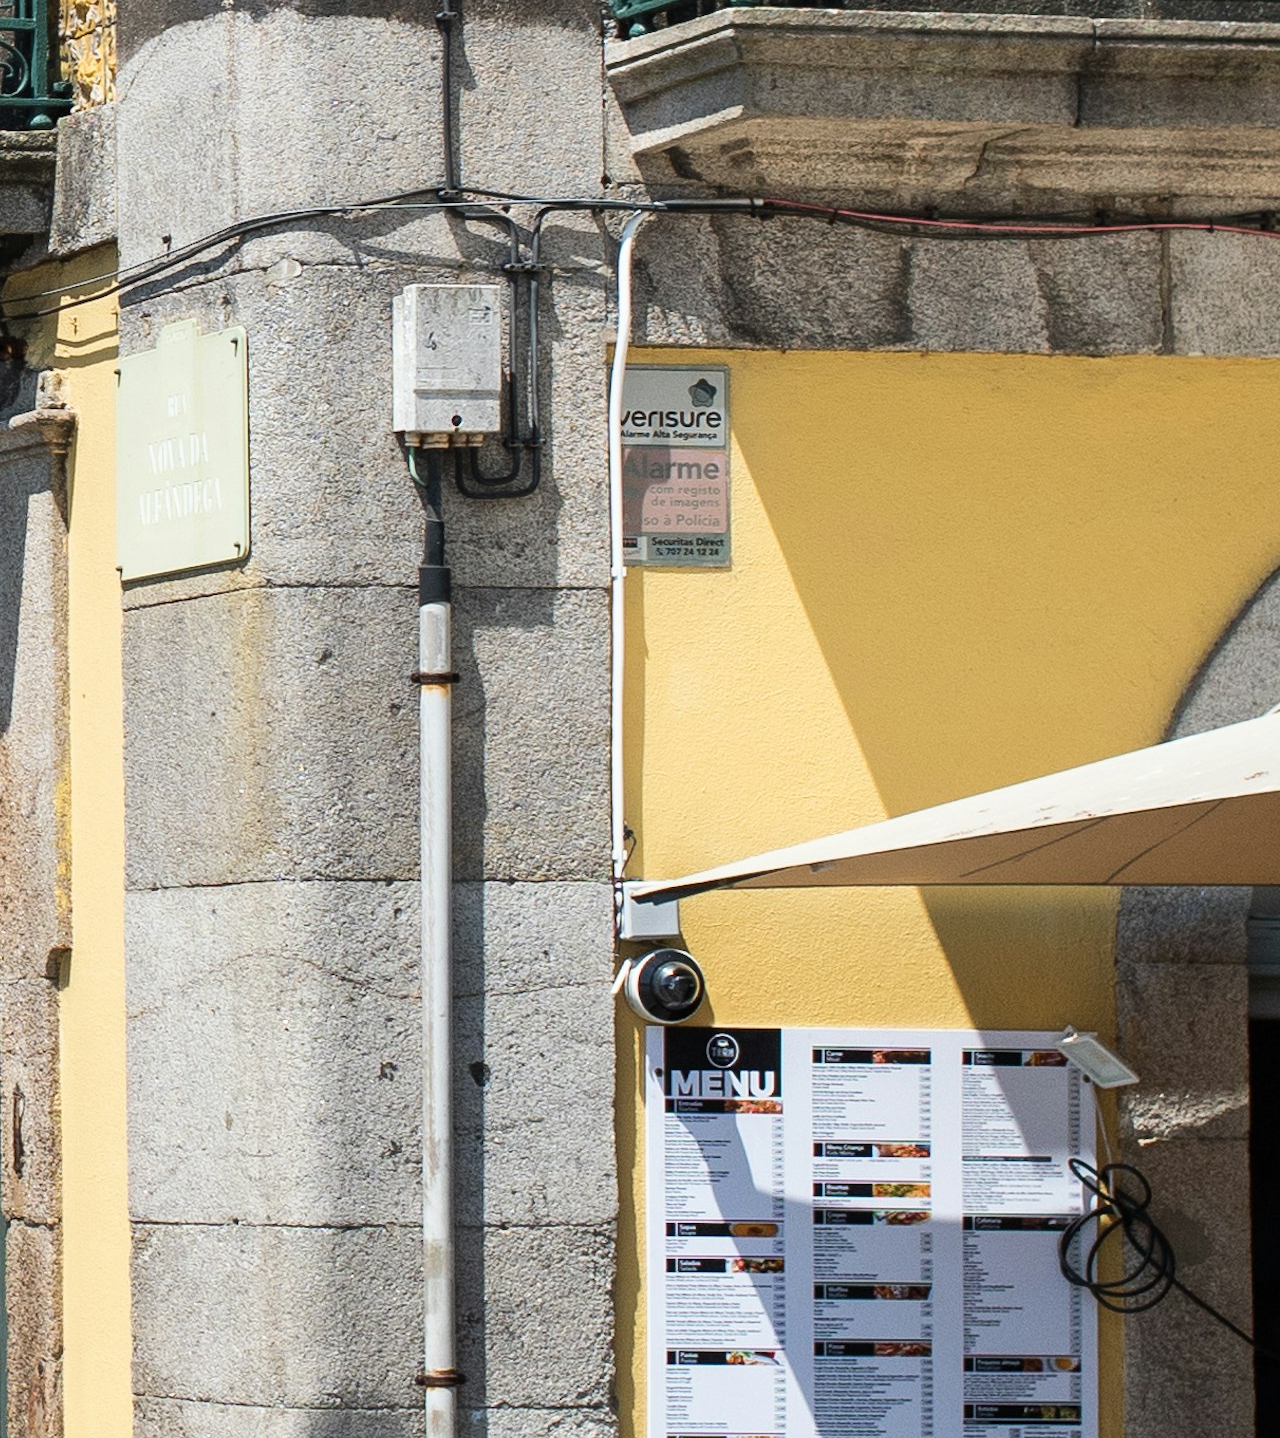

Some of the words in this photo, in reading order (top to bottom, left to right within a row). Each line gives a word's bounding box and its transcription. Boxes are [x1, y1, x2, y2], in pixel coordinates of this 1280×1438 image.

[653, 429, 671, 439] Alta
[672, 430, 718, 441] Segurança
[650, 486, 674, 495] com
[678, 485, 721, 498] registo
[650, 496, 667, 507] de
[670, 496, 720, 511] imagens
[650, 536, 694, 547] Securitas
[695, 536, 726, 547] Direct
[665, 547, 681, 556] 707
[683, 547, 695, 556] 24
[696, 547, 707, 556] 12
[708, 547, 720, 556] 24
[671, 1069, 775, 1099] MENU
